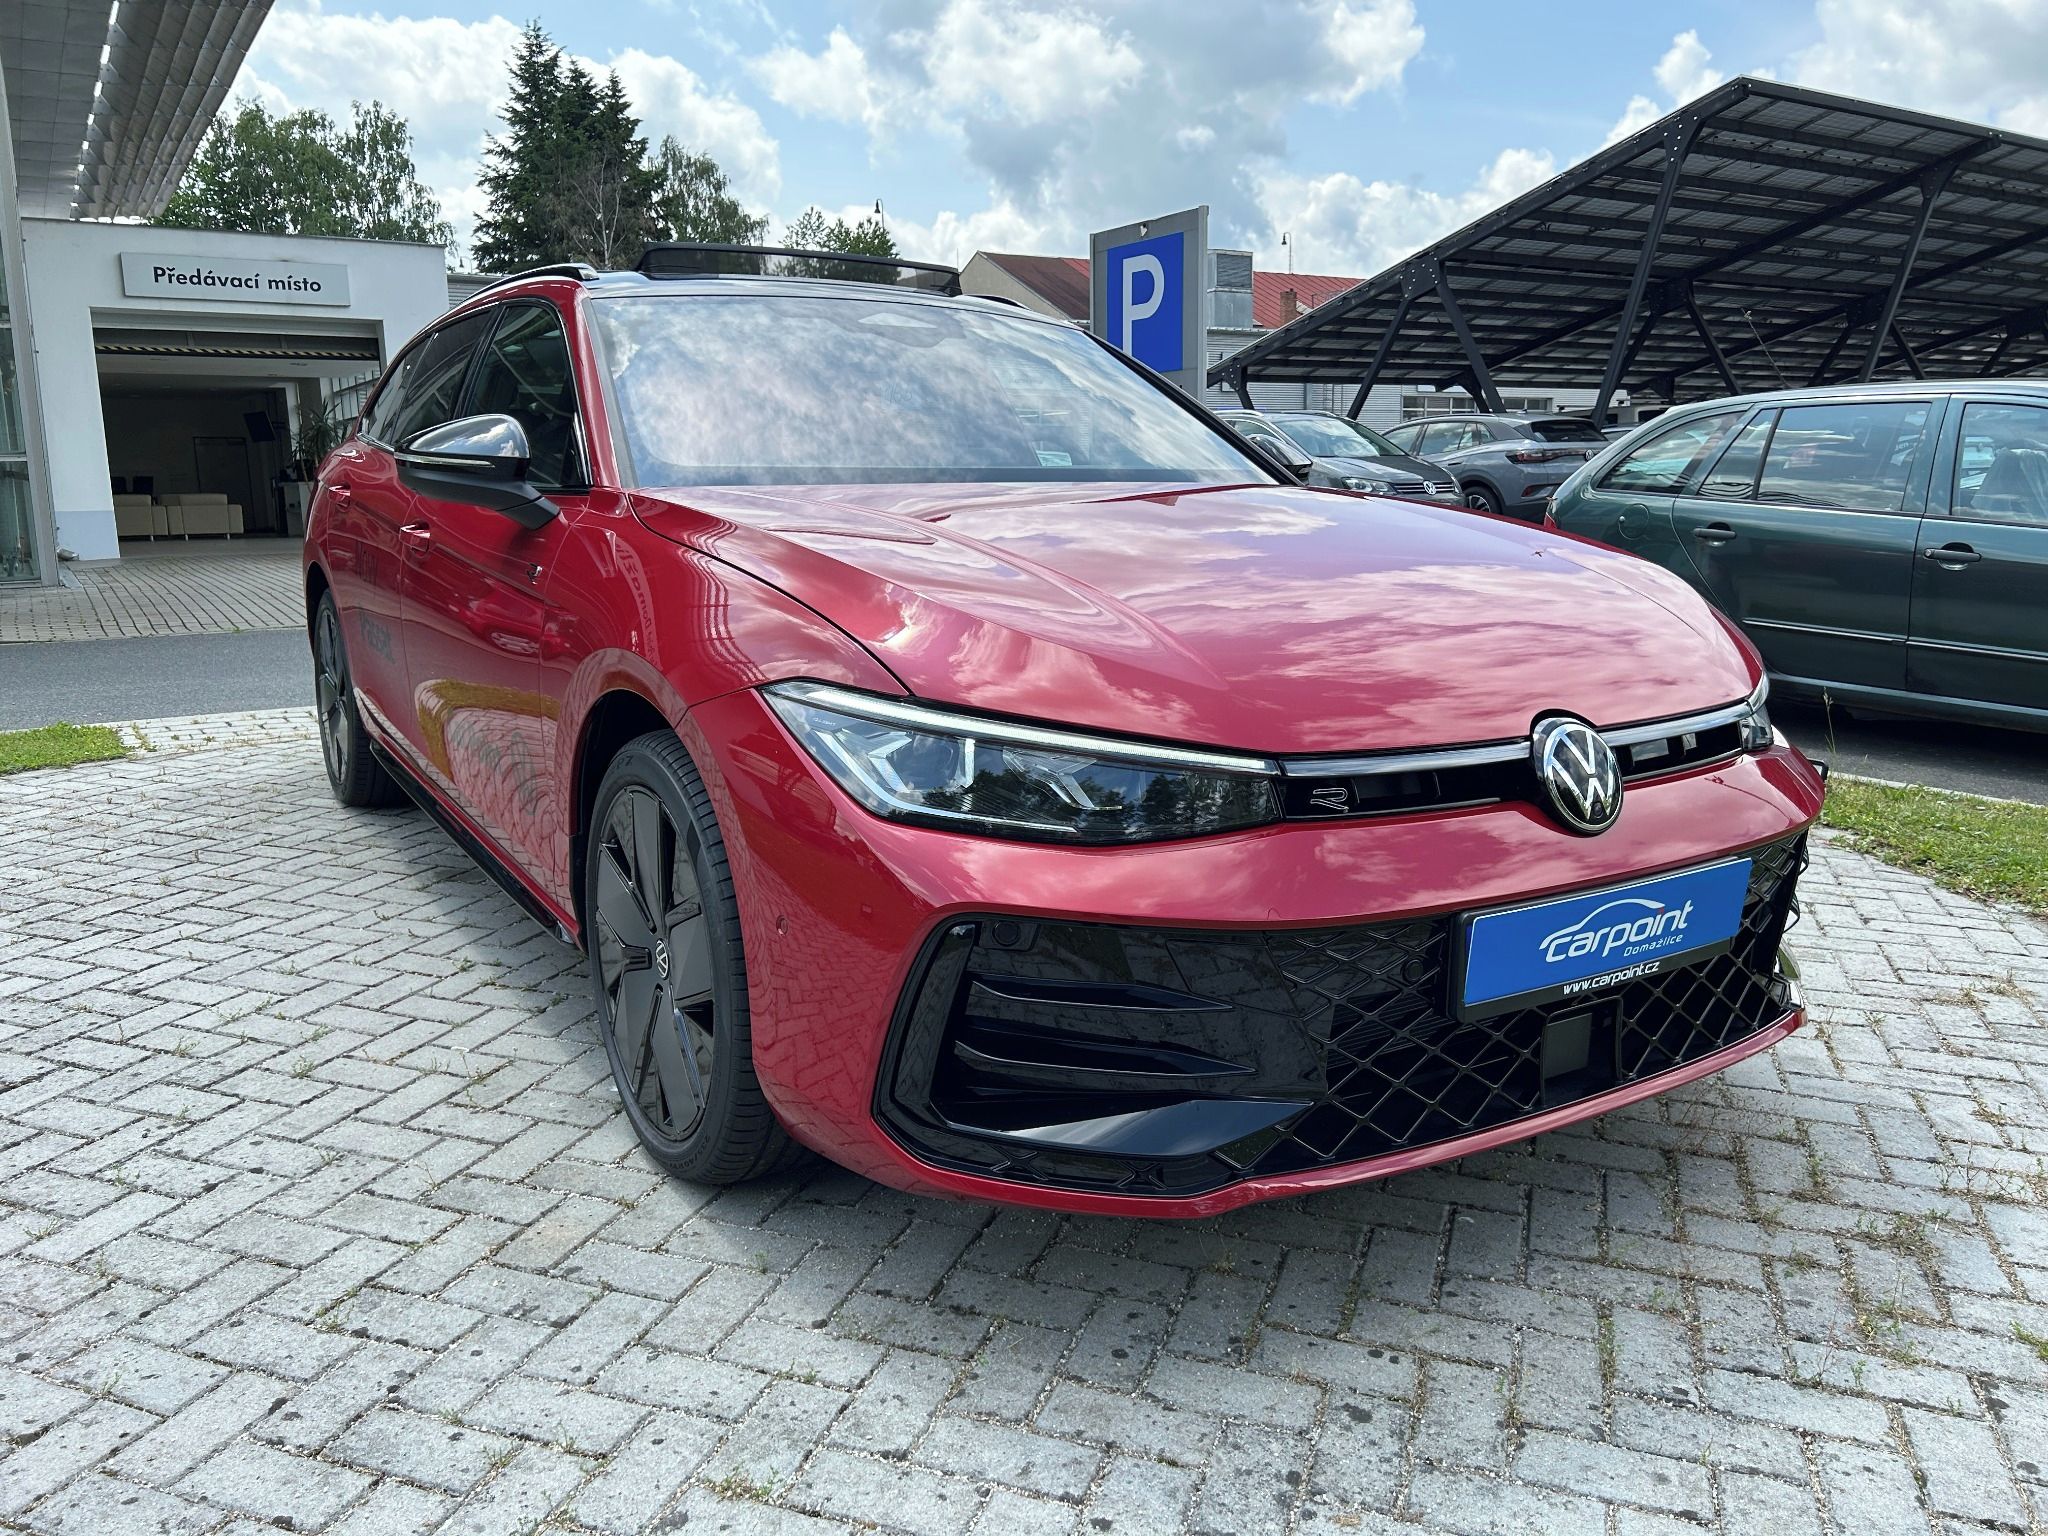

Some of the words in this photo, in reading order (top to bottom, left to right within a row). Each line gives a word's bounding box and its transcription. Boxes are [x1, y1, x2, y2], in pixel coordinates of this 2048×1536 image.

[153, 266, 260, 289] Předávací
[267, 275, 322, 293] místo
[1122, 253, 1165, 357] P
[1545, 900, 1694, 963] carpoint
[1623, 934, 1684, 957] Domažlice
[1563, 961, 1661, 995] www.carpoint.cz
